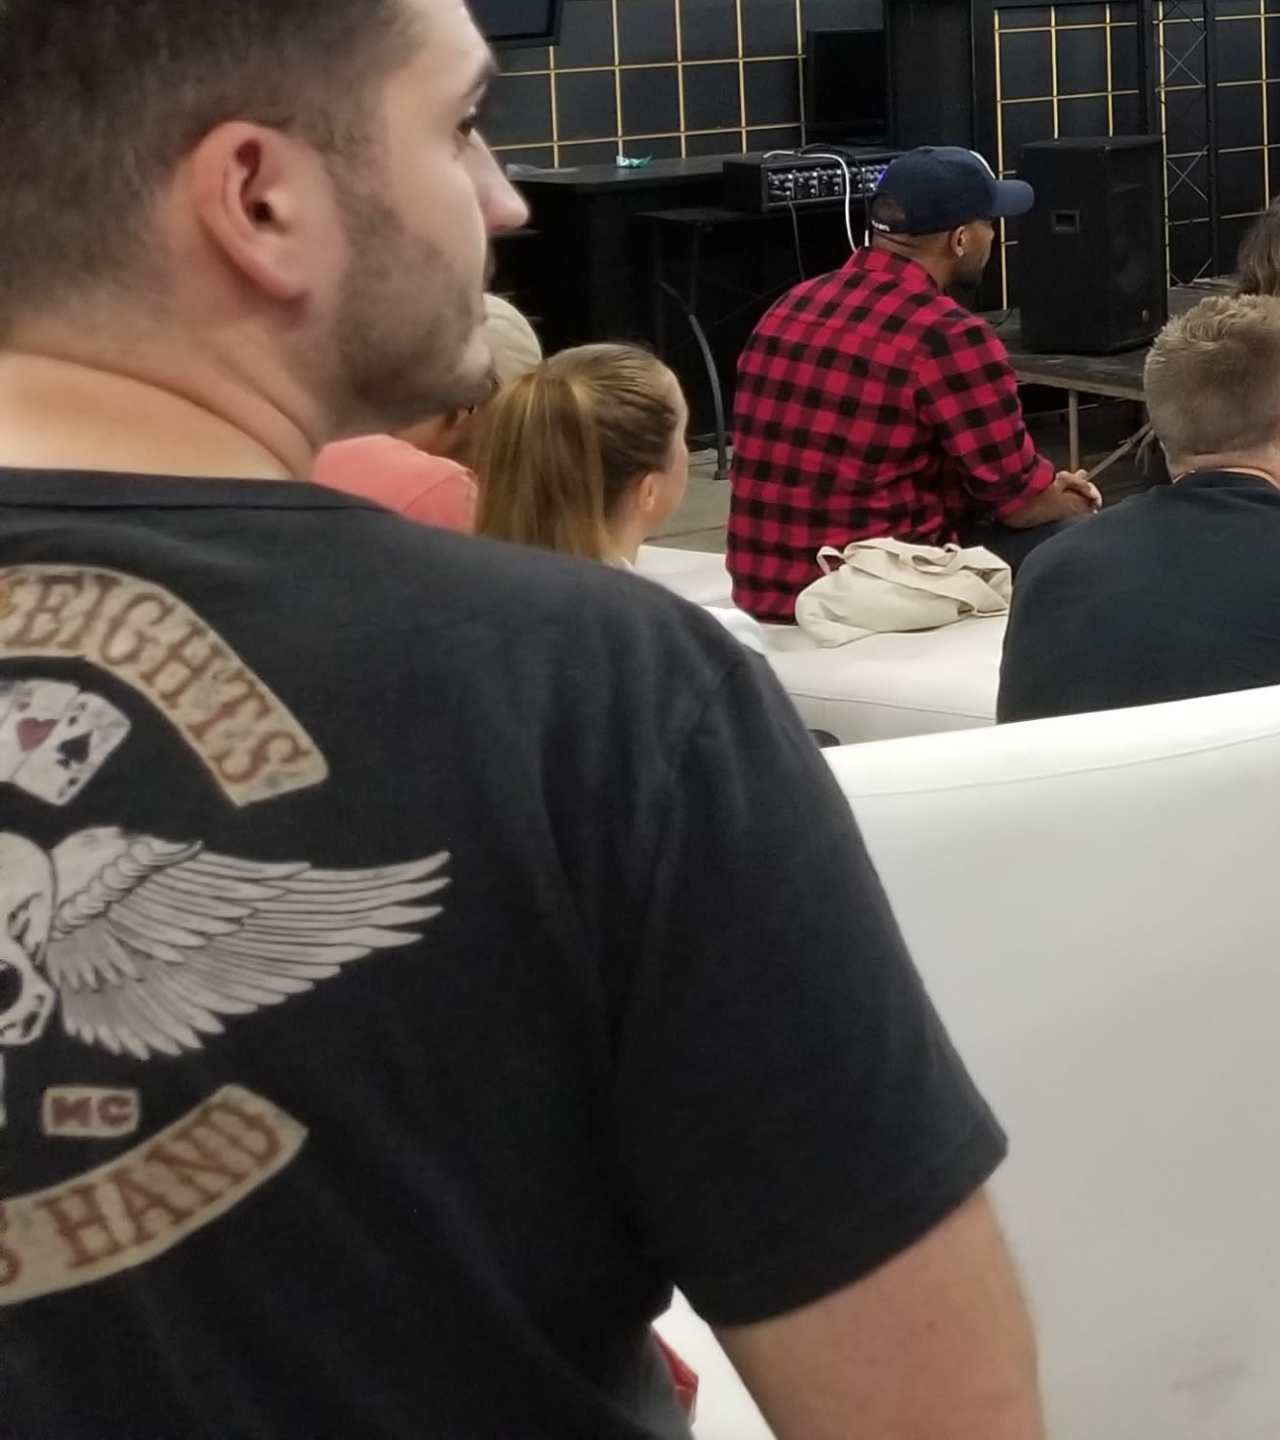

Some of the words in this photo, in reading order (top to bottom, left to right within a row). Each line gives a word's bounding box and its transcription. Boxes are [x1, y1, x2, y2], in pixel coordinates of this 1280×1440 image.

[4, 572, 314, 785] EIGHTS
[34, 1101, 281, 1271] HAND
[51, 1094, 133, 1128] MC
